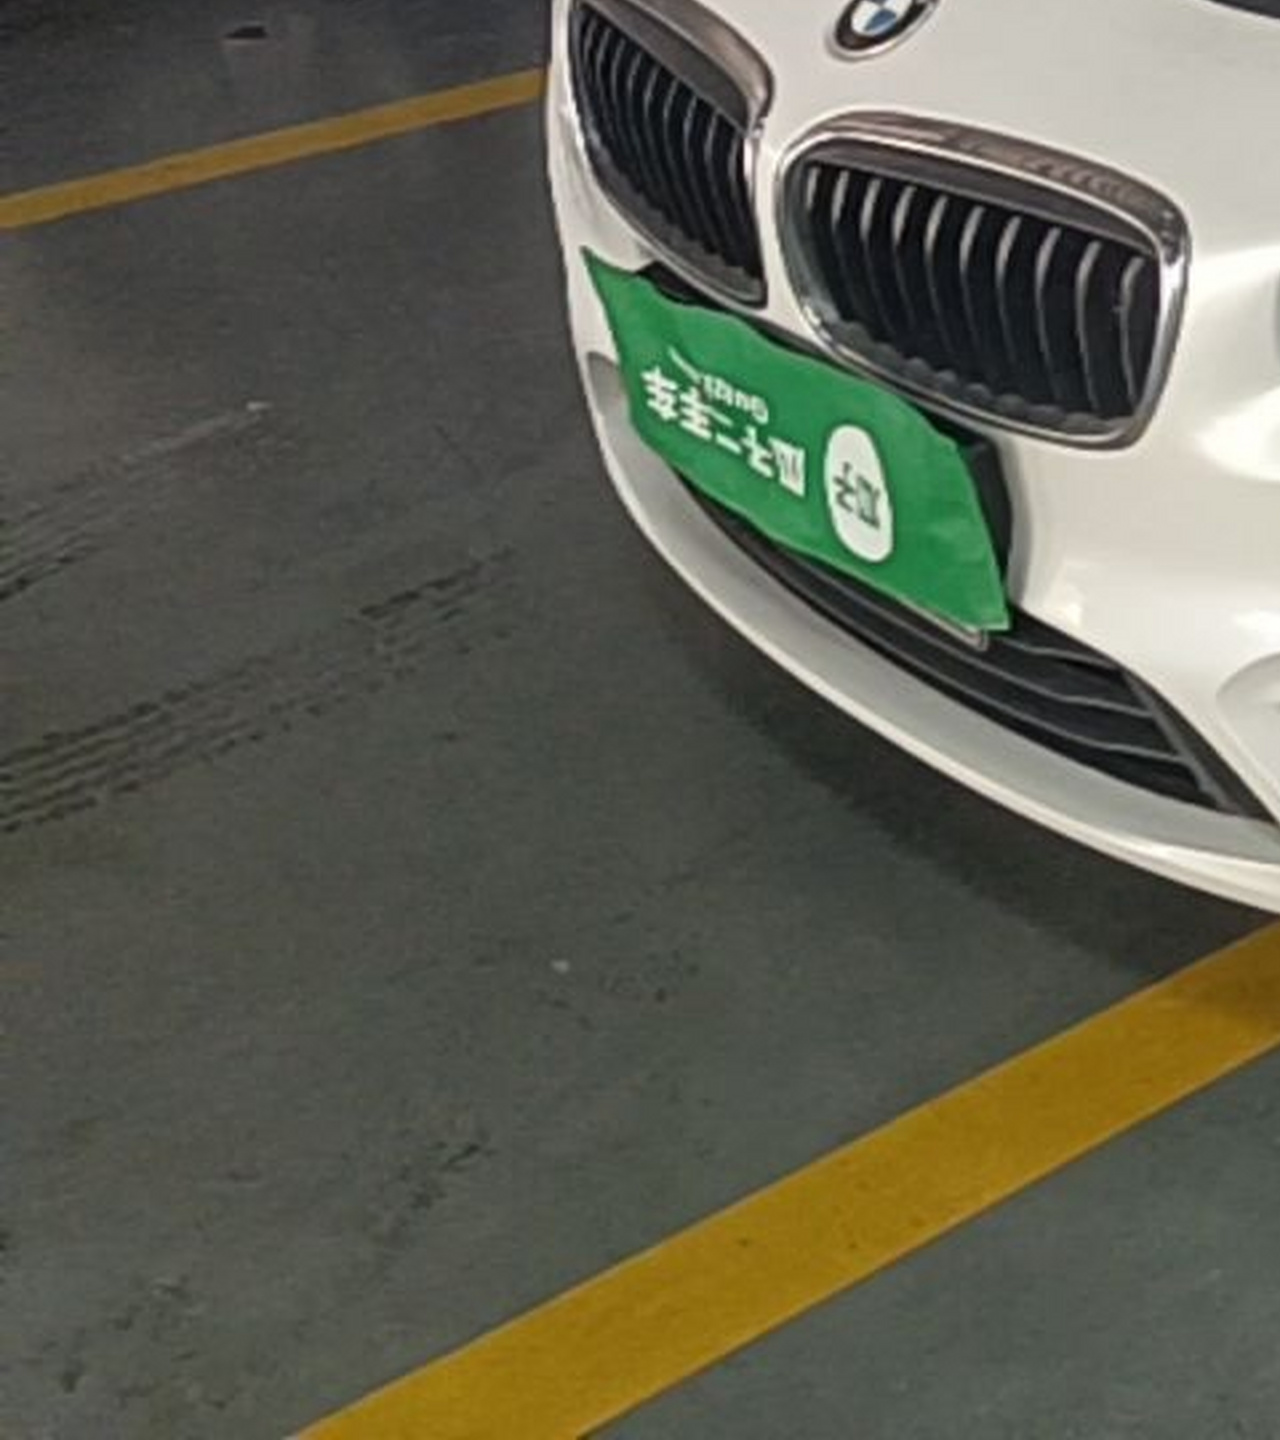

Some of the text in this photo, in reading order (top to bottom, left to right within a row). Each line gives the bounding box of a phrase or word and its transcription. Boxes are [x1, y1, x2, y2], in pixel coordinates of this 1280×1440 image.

[640, 365, 806, 498] 瓜子二手车
